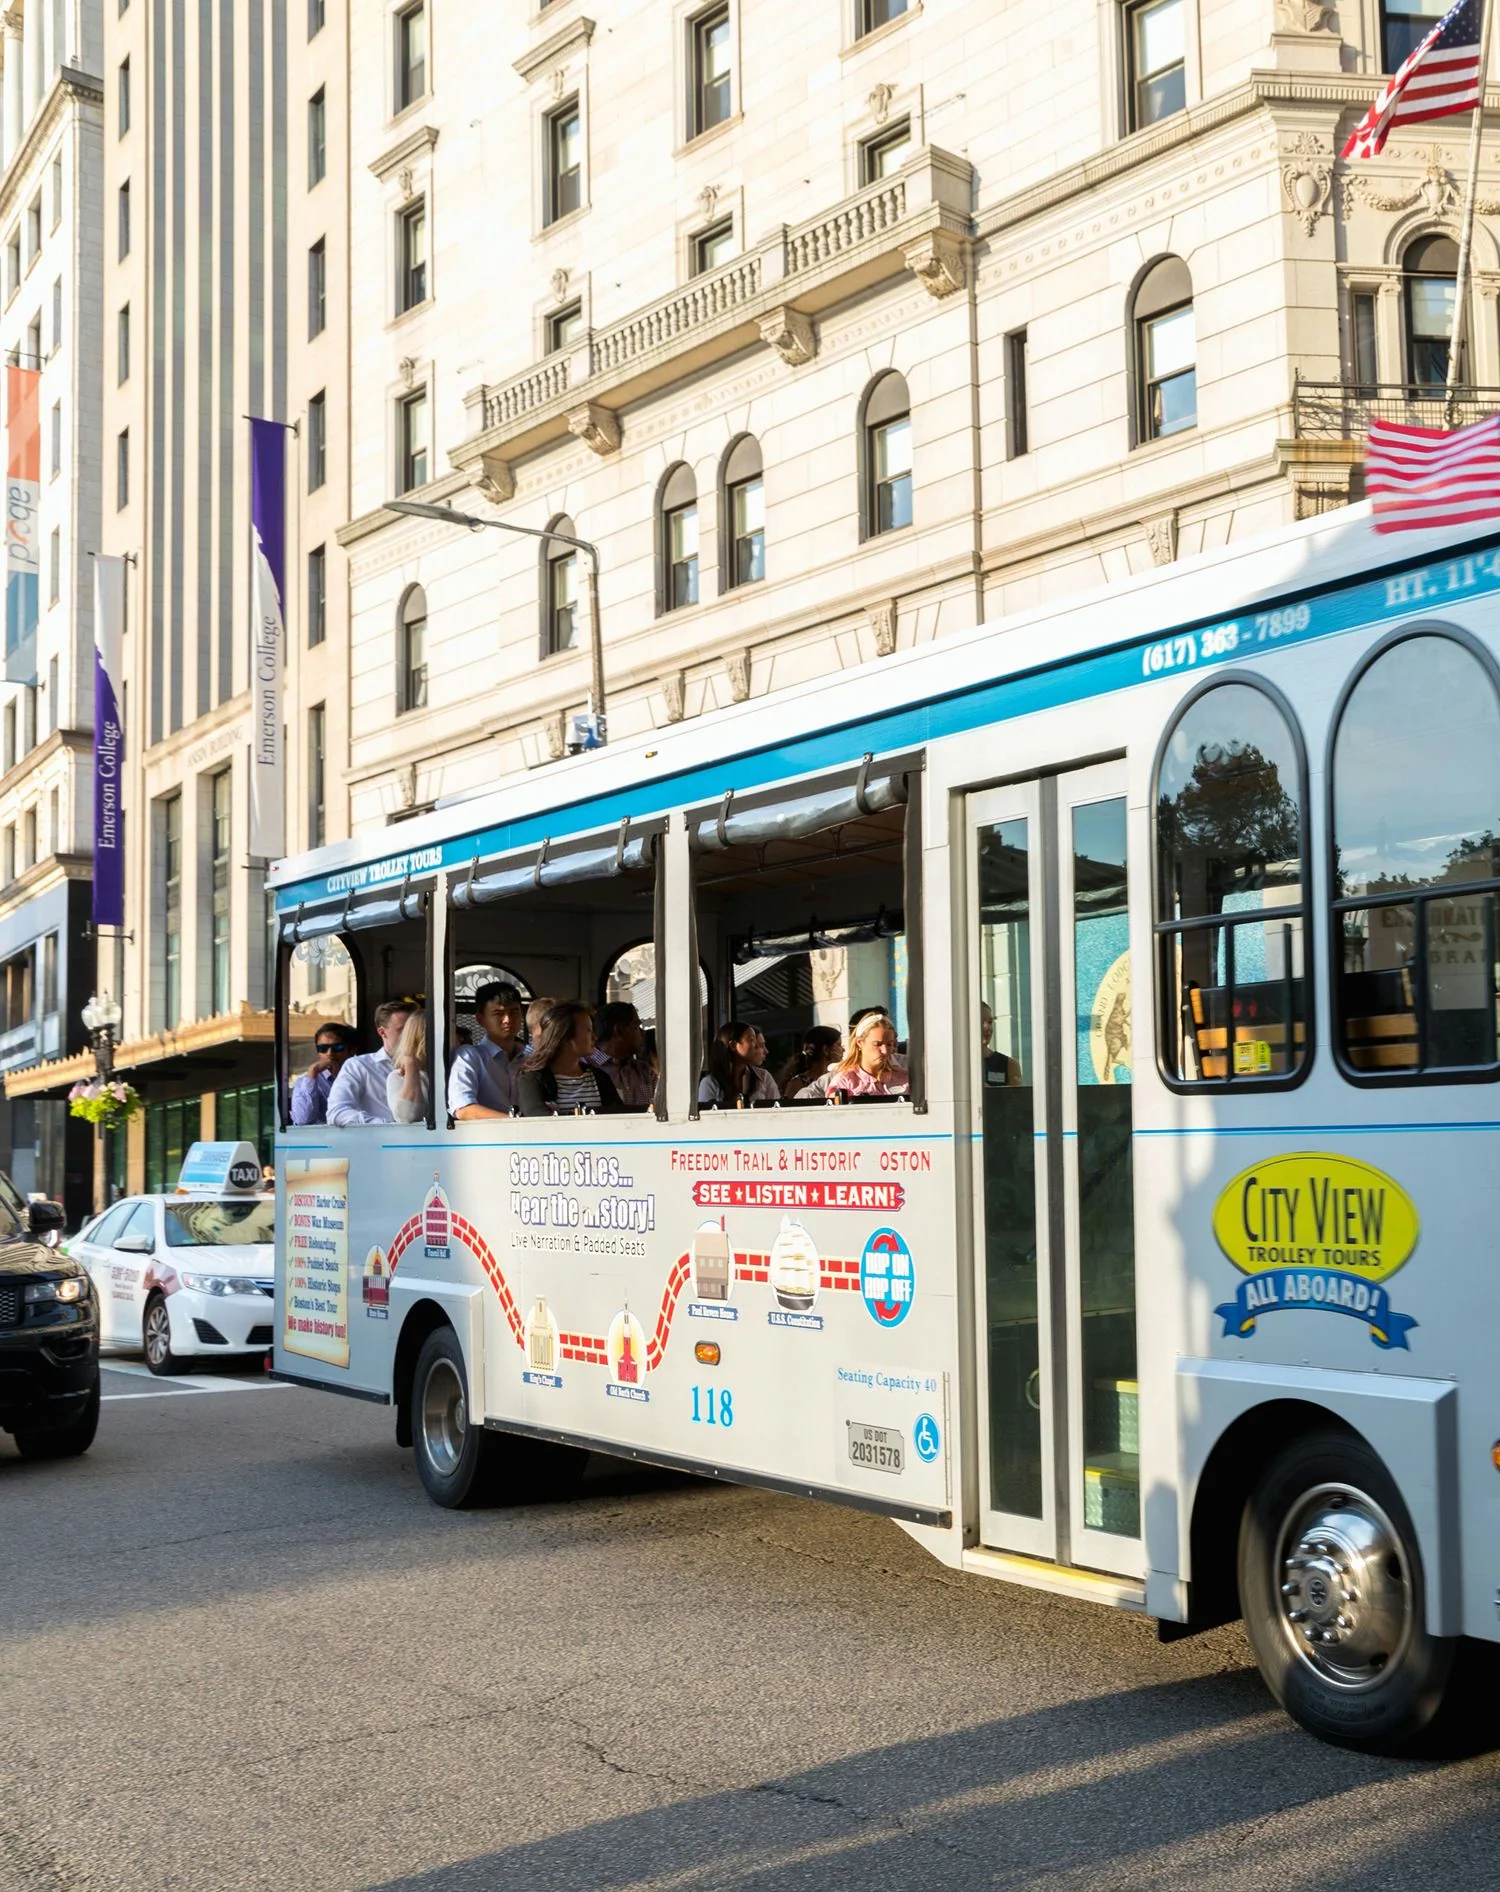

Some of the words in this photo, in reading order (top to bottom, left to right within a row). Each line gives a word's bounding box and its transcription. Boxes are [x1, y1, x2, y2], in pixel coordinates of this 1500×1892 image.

[1384, 570, 1437, 608] HT.
[256, 616, 280, 682] College
[1142, 635, 1197, 677] (617)
[1201, 623, 1239, 658] 363
[1255, 604, 1311, 641] 7899
[257, 689, 276, 766] Emerson
[98, 721, 121, 778] College
[98, 783, 116, 849] Emerson
[327, 868, 367, 893] CITYVIEW
[369, 856, 410, 882] TROLLEY
[410, 845, 443, 871] TOURS
[1107, 960, 1130, 991] LODG
[231, 1168, 258, 1181] TAXI
[510, 1151, 539, 1186] See
[542, 1152, 570, 1186] the
[671, 1150, 729, 1171] FREEDOM
[734, 1150, 773, 1171] TRAIL
[779, 1149, 788, 1170] &
[794, 1148, 861, 1171] HISTORIC
[879, 1150, 931, 1171] OSTON
[551, 1192, 579, 1227] the
[700, 1184, 731, 1203] SEE
[745, 1185, 807, 1206] LISTEN
[823, 1185, 896, 1208] LEARN!
[1242, 1176, 1299, 1243] CITY
[1309, 1177, 1386, 1245] VIEW
[294, 1235, 308, 1249] FREE
[511, 1232, 528, 1248] Live
[530, 1233, 571, 1251] Narration
[573, 1235, 580, 1252] &
[583, 1235, 617, 1254] Padded
[620, 1238, 646, 1256] Seats
[1247, 1246, 1317, 1265] TROLLEY
[1322, 1248, 1382, 1267] TOURS
[865, 1251, 890, 1275] HOP
[892, 1253, 909, 1277] ON
[864, 1276, 889, 1300] HOP
[891, 1278, 912, 1302] OFF
[1245, 1276, 1279, 1311] ALL
[1284, 1274, 1381, 1317] ABOARD!
[288, 1315, 296, 1330] We
[297, 1317, 313, 1333] make
[313, 1319, 334, 1338] history
[837, 1367, 873, 1388] Seating
[876, 1372, 921, 1395] Capacity
[925, 1378, 937, 1392] 40
[691, 1385, 733, 1427] 118
[863, 1428, 873, 1441] US
[874, 1430, 888, 1443] DOT
[852, 1441, 901, 1468] 2031578
